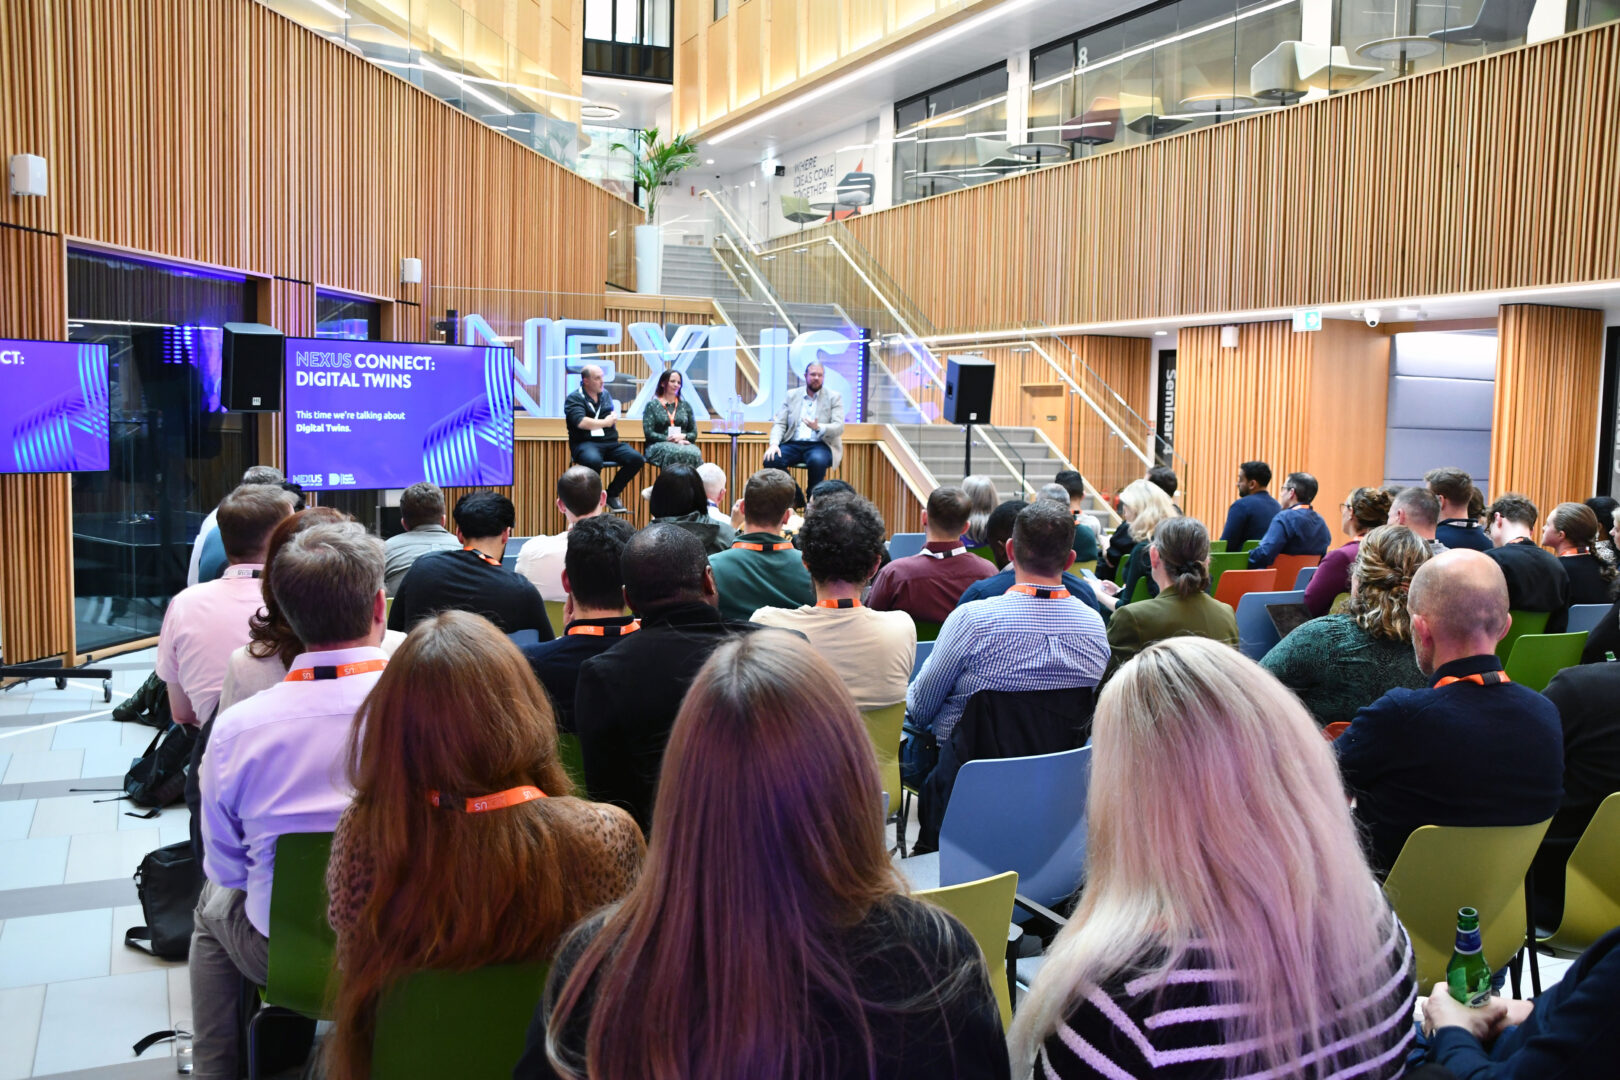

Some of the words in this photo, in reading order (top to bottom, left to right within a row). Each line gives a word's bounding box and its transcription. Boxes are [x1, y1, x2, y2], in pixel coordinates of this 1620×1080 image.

[1078, 46, 1088, 68] 8
[794, 156, 818, 172] WHERE
[794, 171, 813, 188] IDEAS
[814, 164, 834, 182] COME
[296, 351, 352, 368] NEXUS
[354, 353, 436, 371] CONNECT:
[463, 313, 853, 422] NEXUS
[296, 371, 360, 388] DIGITAL
[362, 372, 412, 389] TWINS
[1164, 368, 1177, 441] Seminar
[296, 410, 313, 420] This
[314, 411, 333, 420] time
[334, 410, 355, 420] we're
[356, 411, 382, 421] talking
[383, 411, 406, 420] about
[296, 423, 325, 434] Digital
[326, 423, 352, 433] Twins.
[1163, 443, 1174, 455] 4
